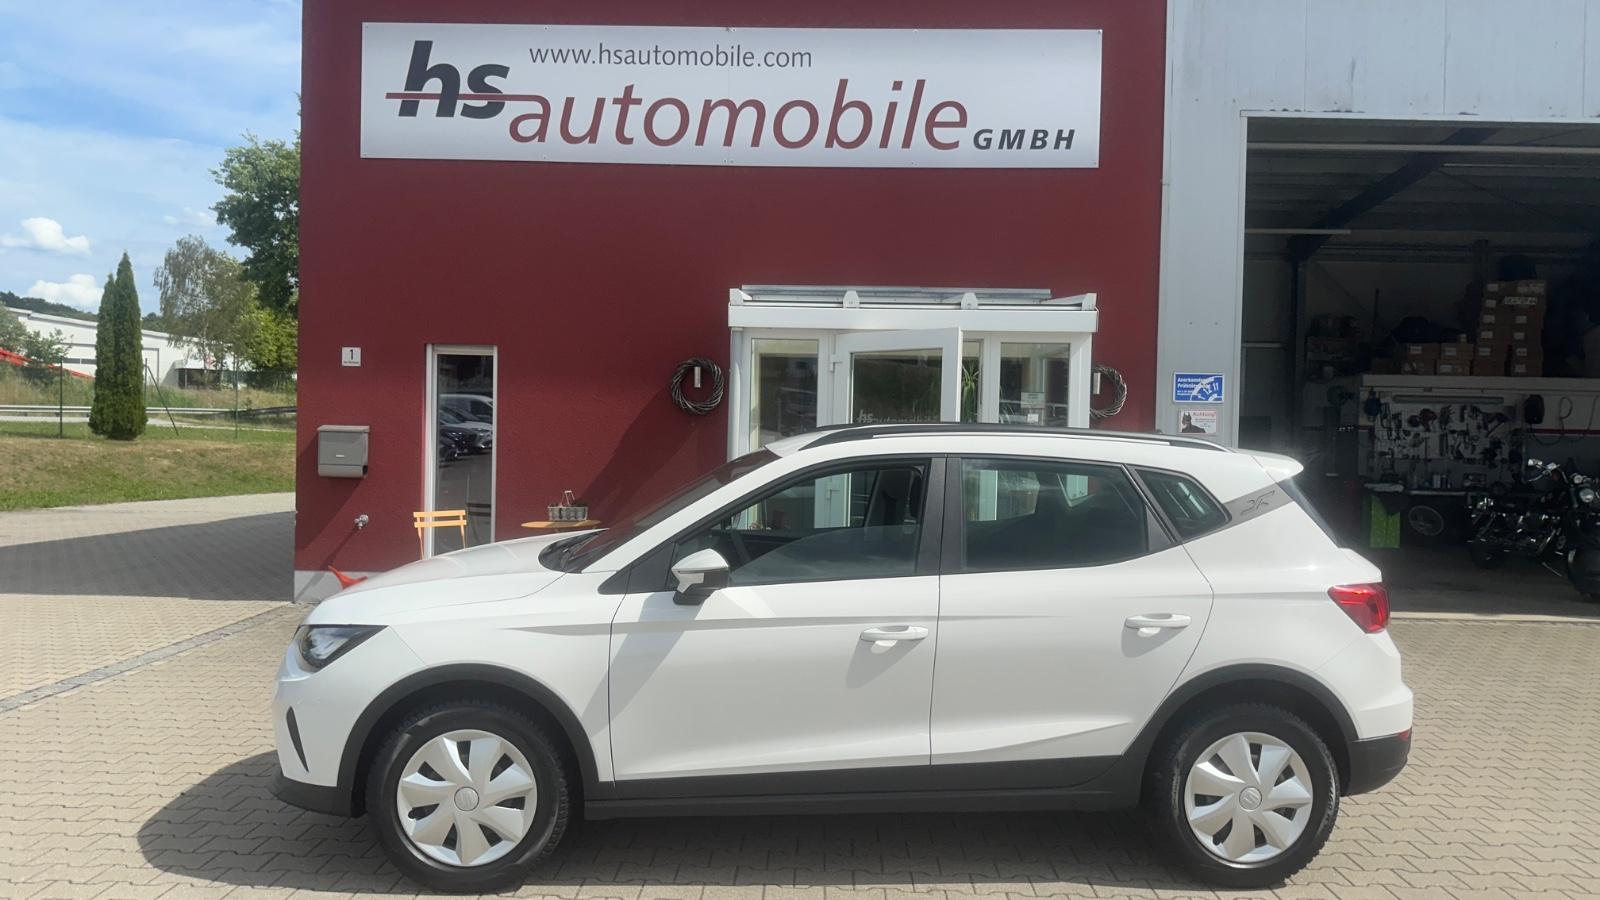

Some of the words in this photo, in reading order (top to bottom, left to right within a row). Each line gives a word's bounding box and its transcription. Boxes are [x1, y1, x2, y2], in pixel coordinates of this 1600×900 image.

[399, 40, 510, 119] hs
[529, 42, 812, 68] www.hsautomobile.com
[508, 79, 968, 151] automobile
[973, 128, 1076, 152] GMBH
[349, 348, 354, 360] 1
